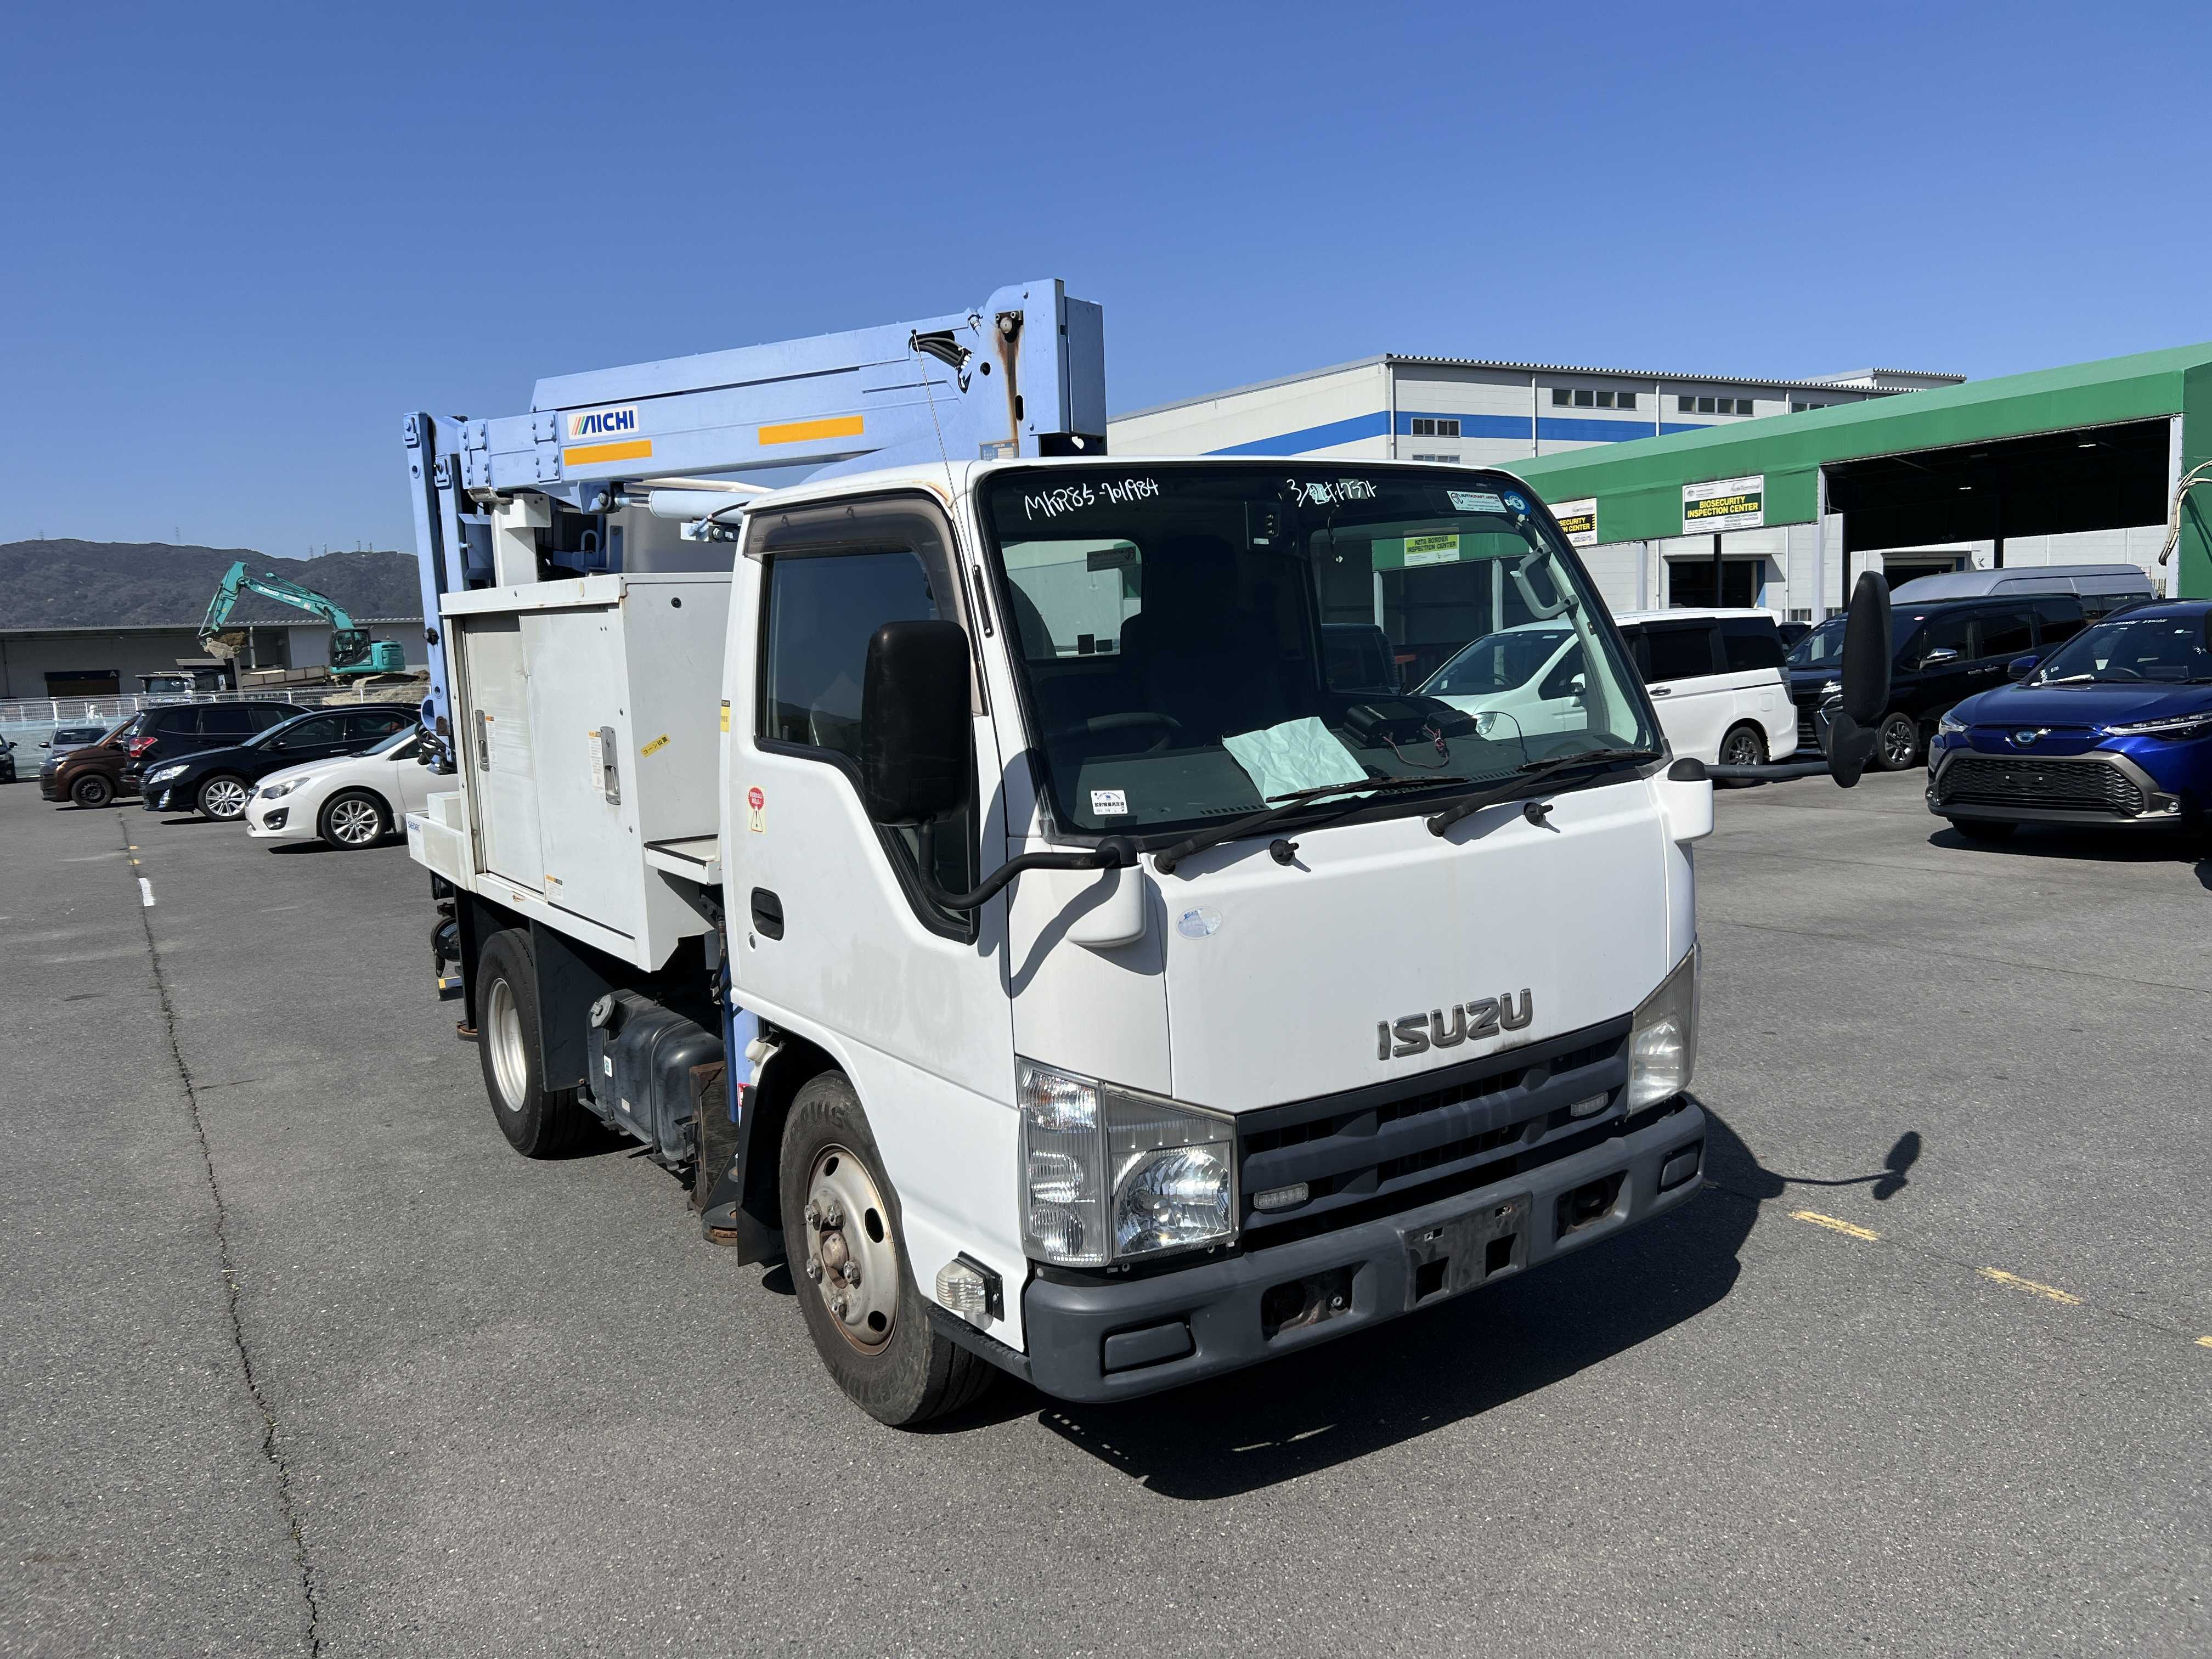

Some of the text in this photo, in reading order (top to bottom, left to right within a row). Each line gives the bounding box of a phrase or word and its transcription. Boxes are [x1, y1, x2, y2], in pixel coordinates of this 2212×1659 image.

[582, 410, 635, 435] AICHI
[1699, 495, 1746, 509] BIOSECURITY
[1687, 502, 1759, 518] INSPECTION CENTER
[1558, 517, 1586, 527] SECURITY
[1569, 523, 1590, 532] CENTER
[1427, 536, 1448, 544] BORDER
[1376, 988, 1533, 1061] ISUZU
